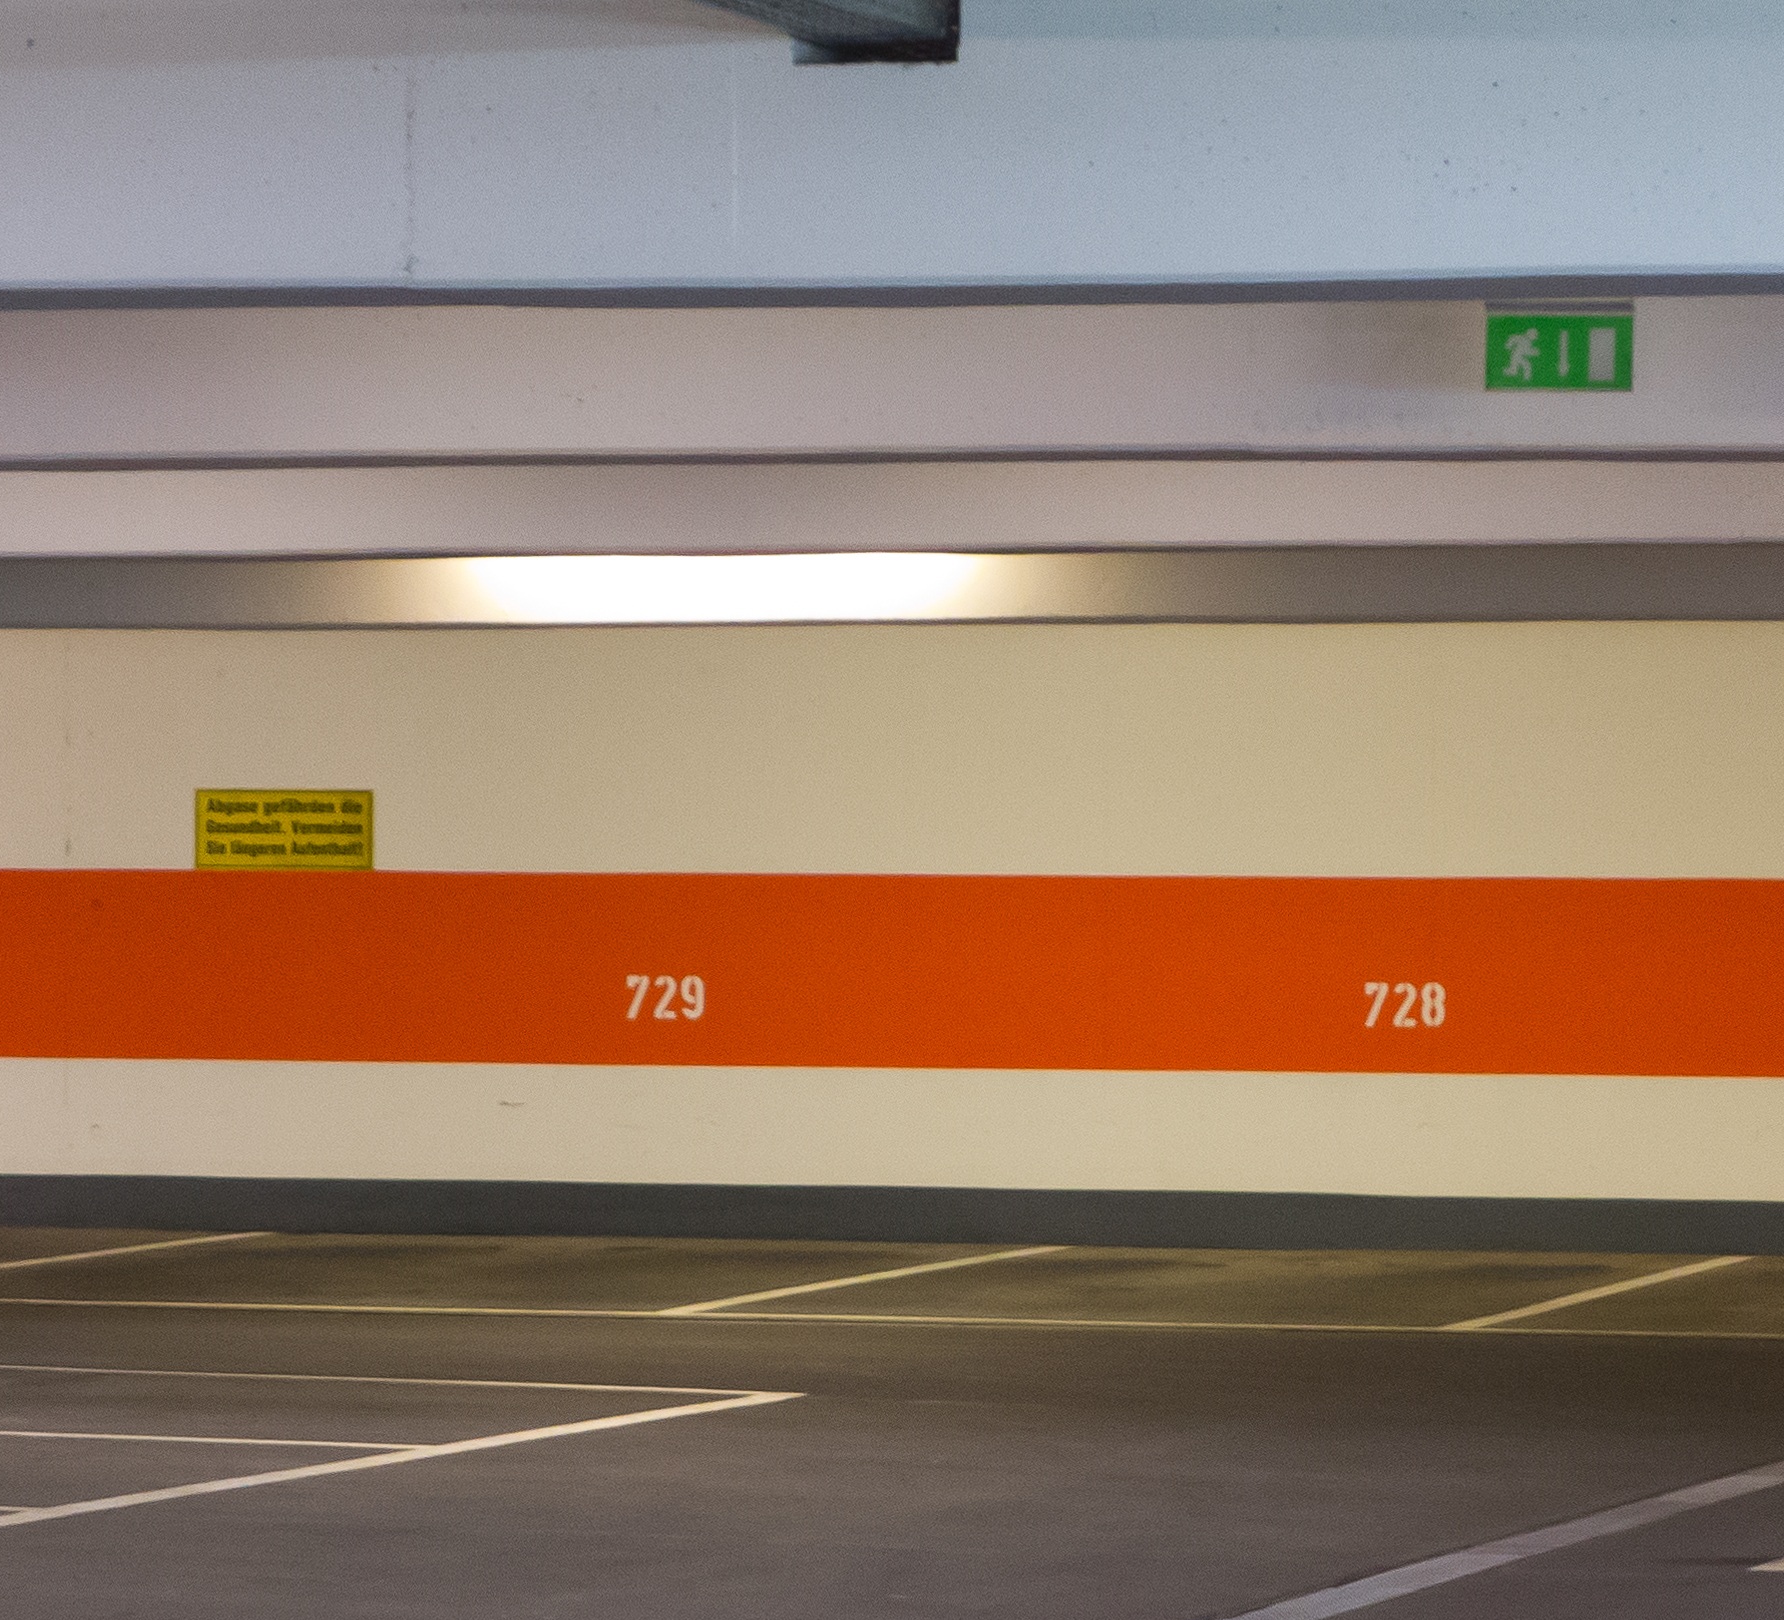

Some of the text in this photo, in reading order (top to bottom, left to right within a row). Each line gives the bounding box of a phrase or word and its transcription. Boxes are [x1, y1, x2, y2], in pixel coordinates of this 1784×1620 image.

[207, 798, 363, 815] Abgase gefährden die
[291, 820, 363, 834] Vermeiden
[206, 839, 227, 855] Sie
[230, 840, 287, 857] längeren
[626, 975, 705, 1020] 729
[1364, 982, 1446, 1028] 728
